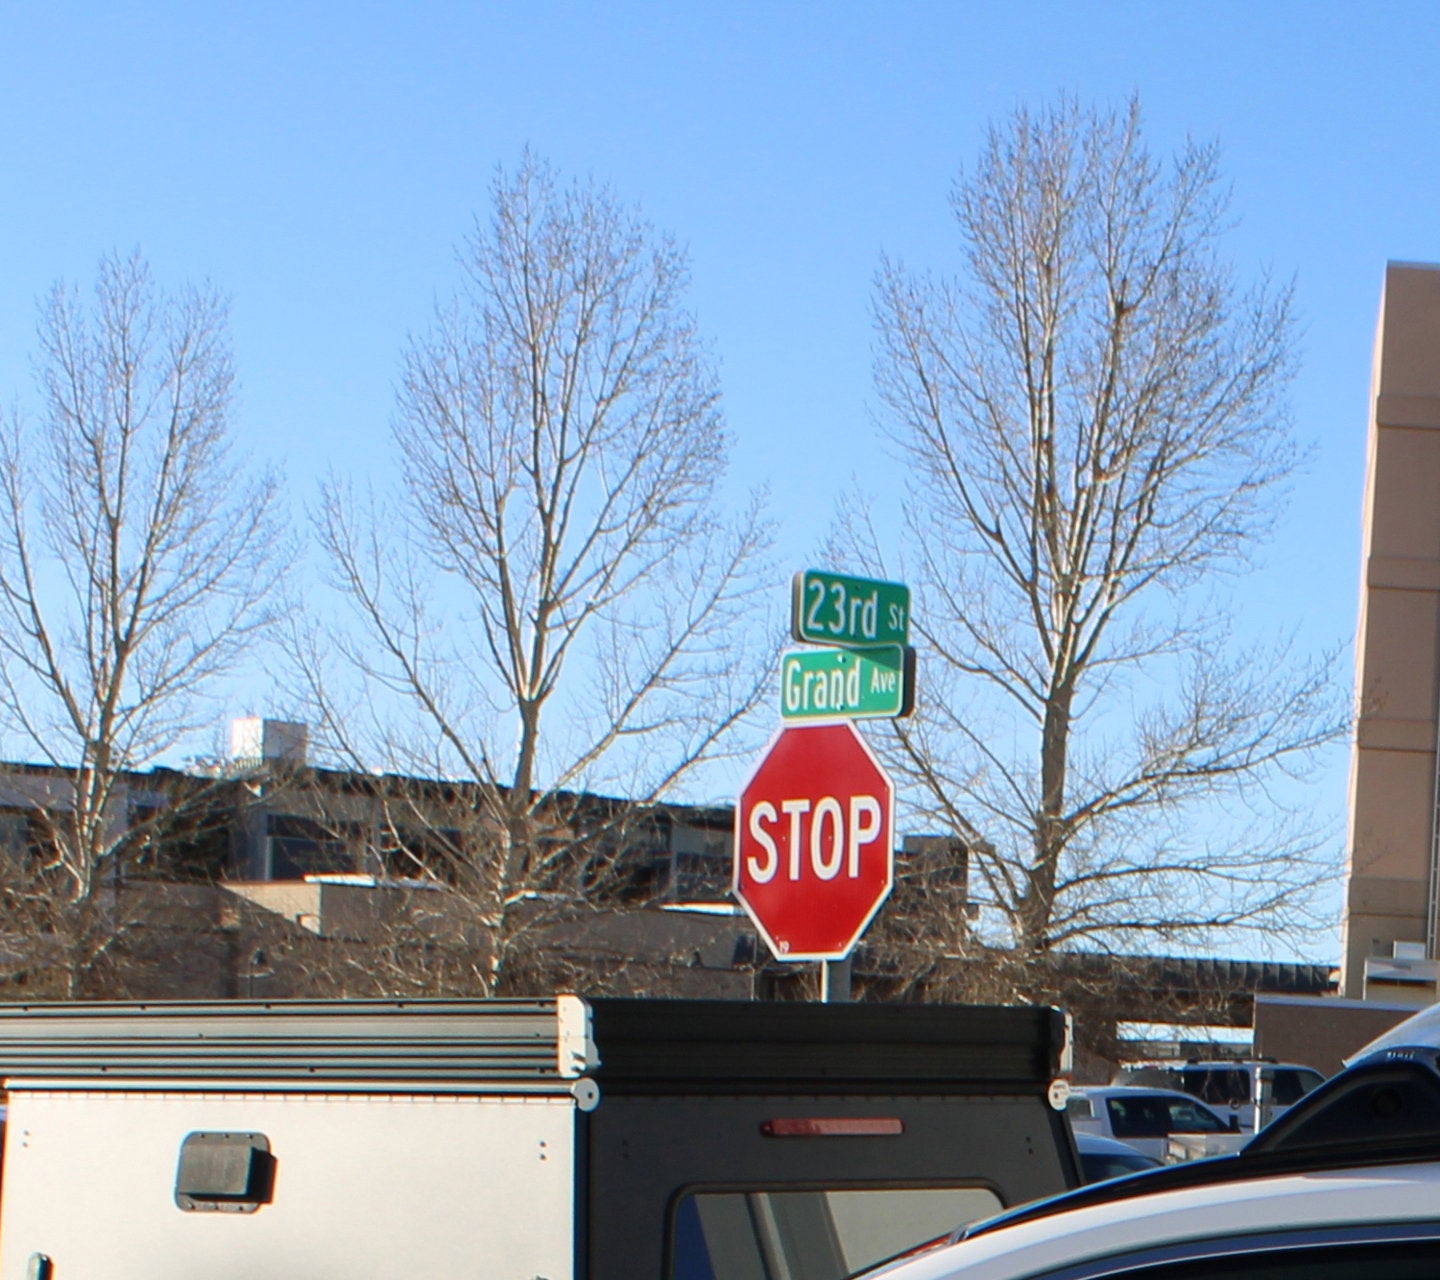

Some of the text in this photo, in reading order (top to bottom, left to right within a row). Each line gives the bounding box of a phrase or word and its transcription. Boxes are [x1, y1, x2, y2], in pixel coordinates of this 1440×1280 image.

[806, 578, 906, 640] 23rd St
[784, 654, 896, 712] Grand Ave
[746, 794, 882, 885] STOP
